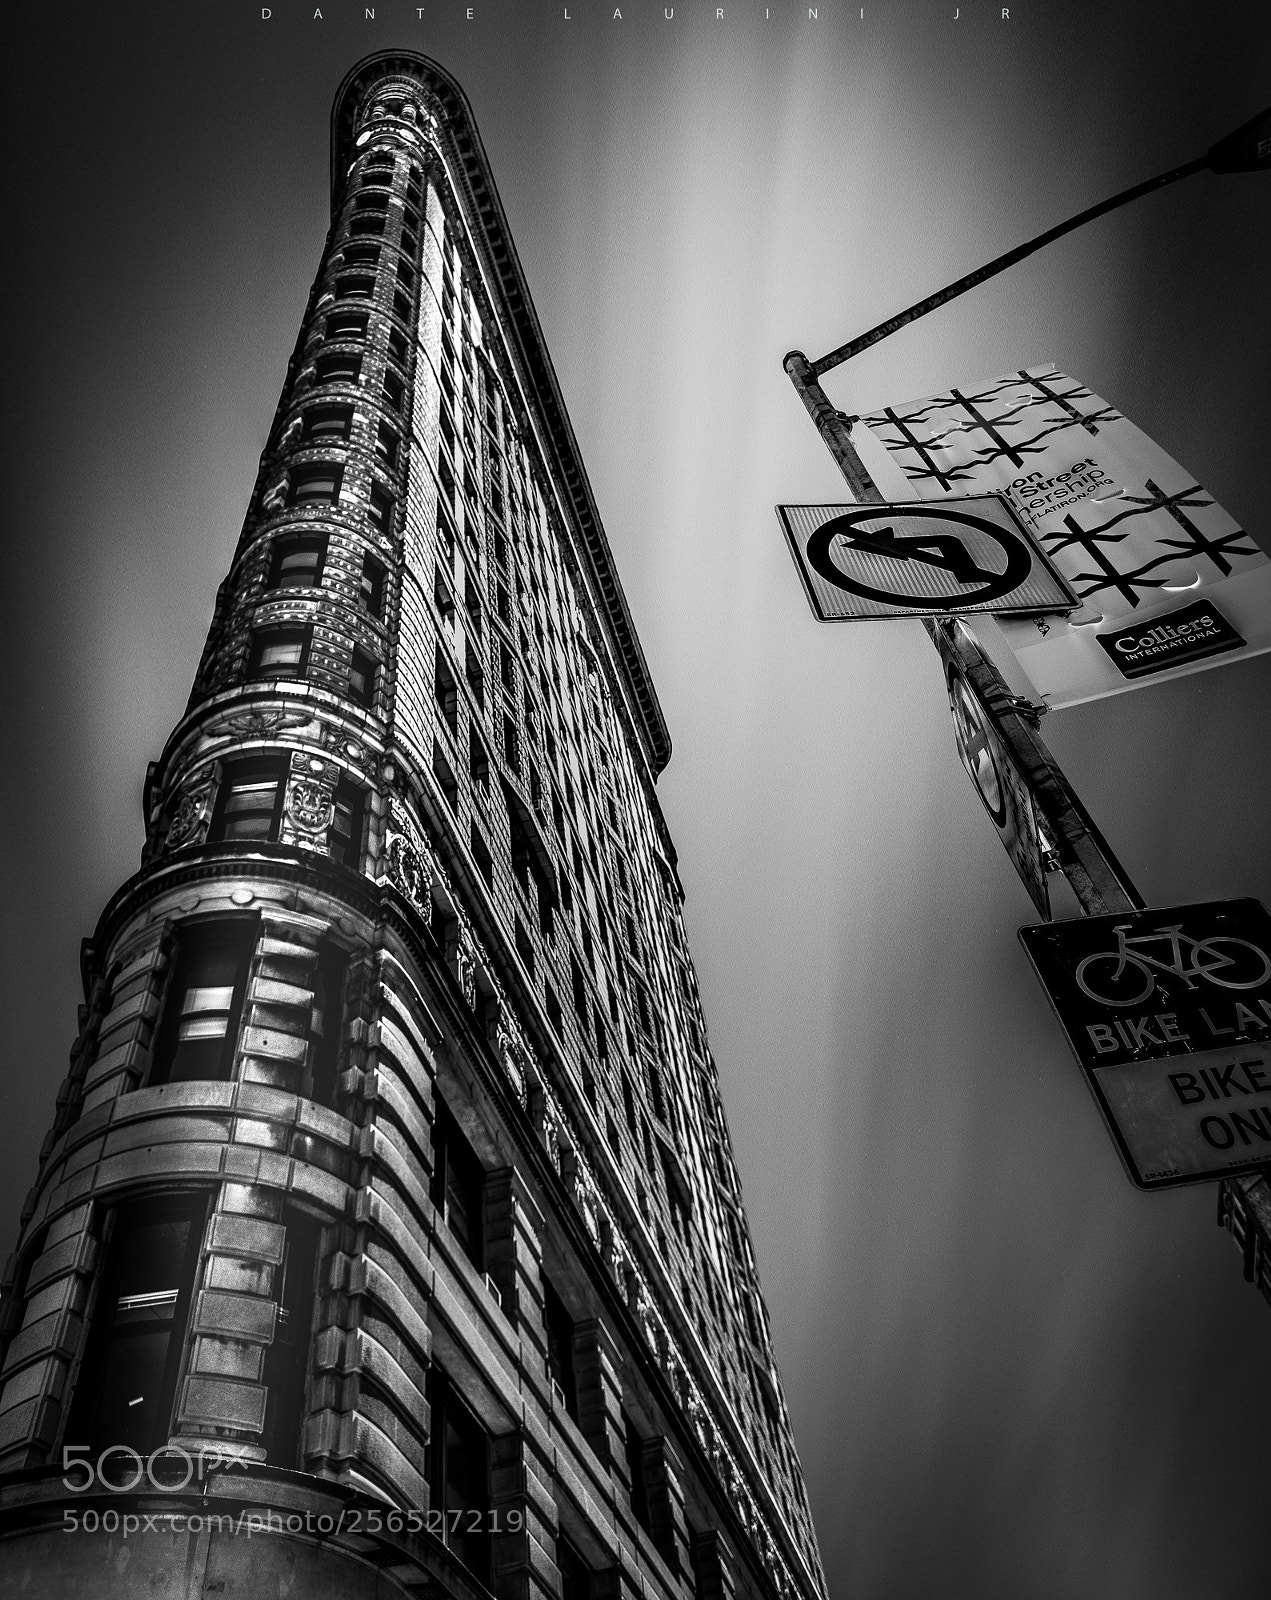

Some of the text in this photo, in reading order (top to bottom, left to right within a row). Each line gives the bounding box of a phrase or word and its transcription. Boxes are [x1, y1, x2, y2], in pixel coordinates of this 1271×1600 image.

[1019, 458, 1099, 497] Street
[1114, 615, 1214, 653] Colliers
[1125, 627, 1222, 661] INTERNATIONAL
[1086, 1013, 1190, 1053] BIKE
[1167, 1060, 1271, 1105] BIKE
